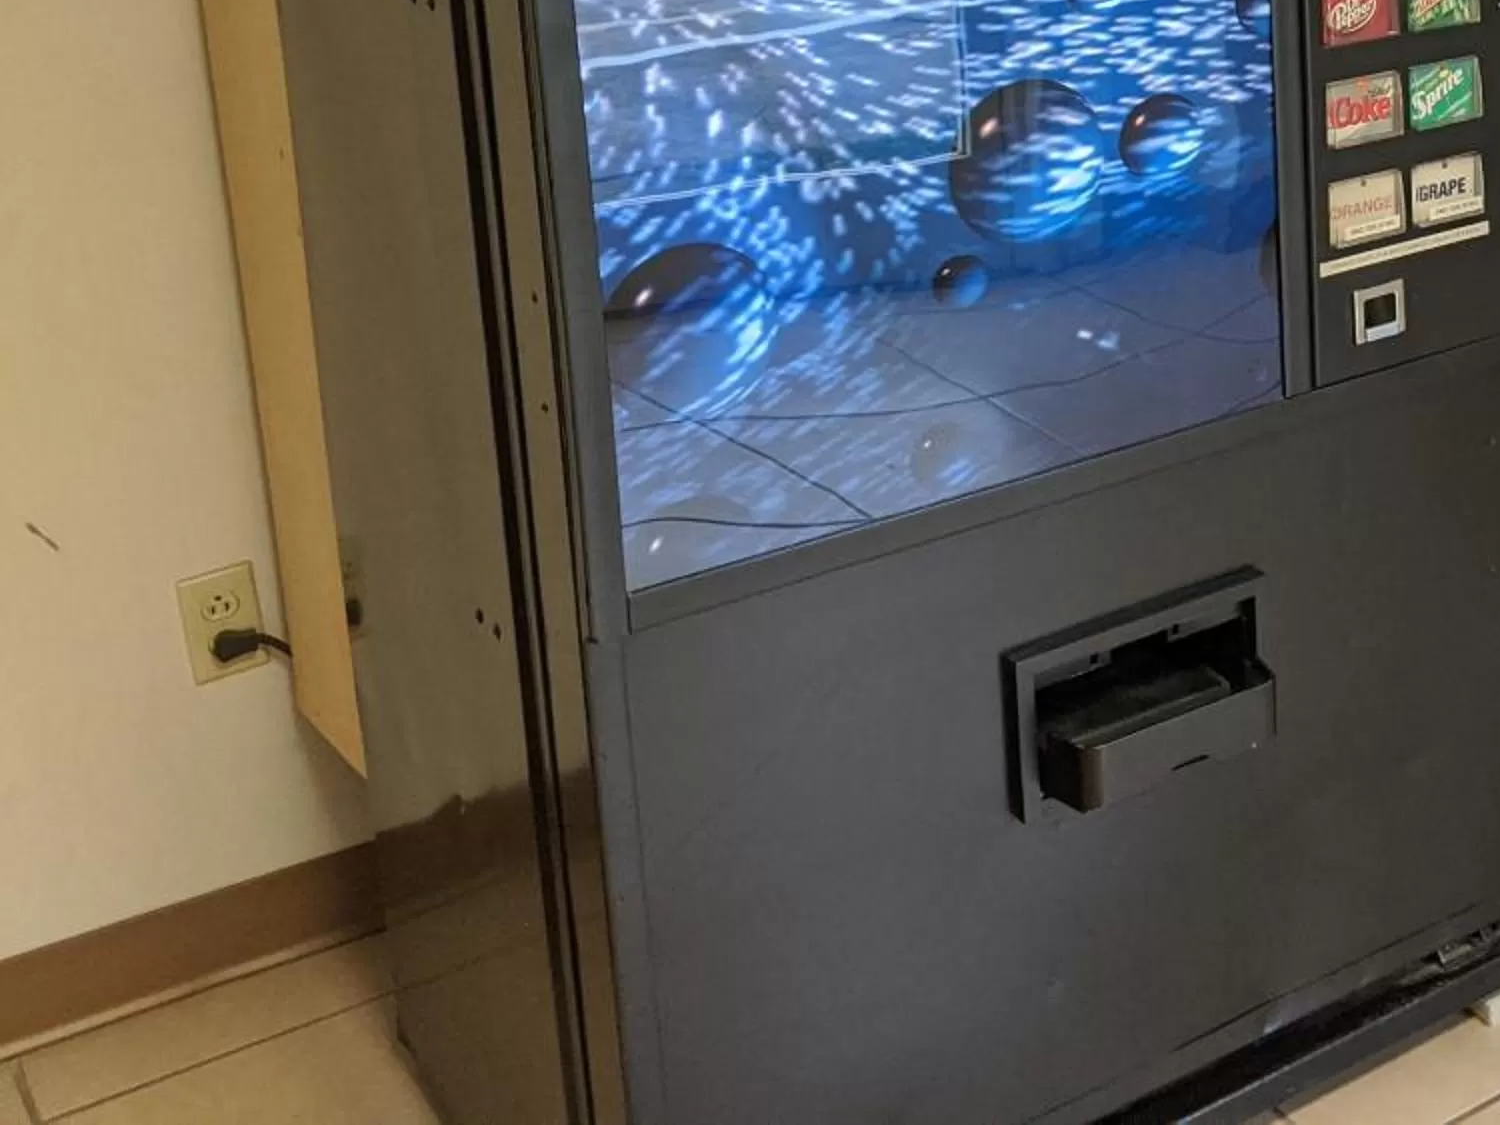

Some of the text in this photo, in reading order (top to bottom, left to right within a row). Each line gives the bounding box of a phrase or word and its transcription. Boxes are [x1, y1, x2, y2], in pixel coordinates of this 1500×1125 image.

[1330, 94, 1391, 129] Coke
[1411, 67, 1464, 121] Sprite
[1417, 176, 1467, 202] GRAPE
